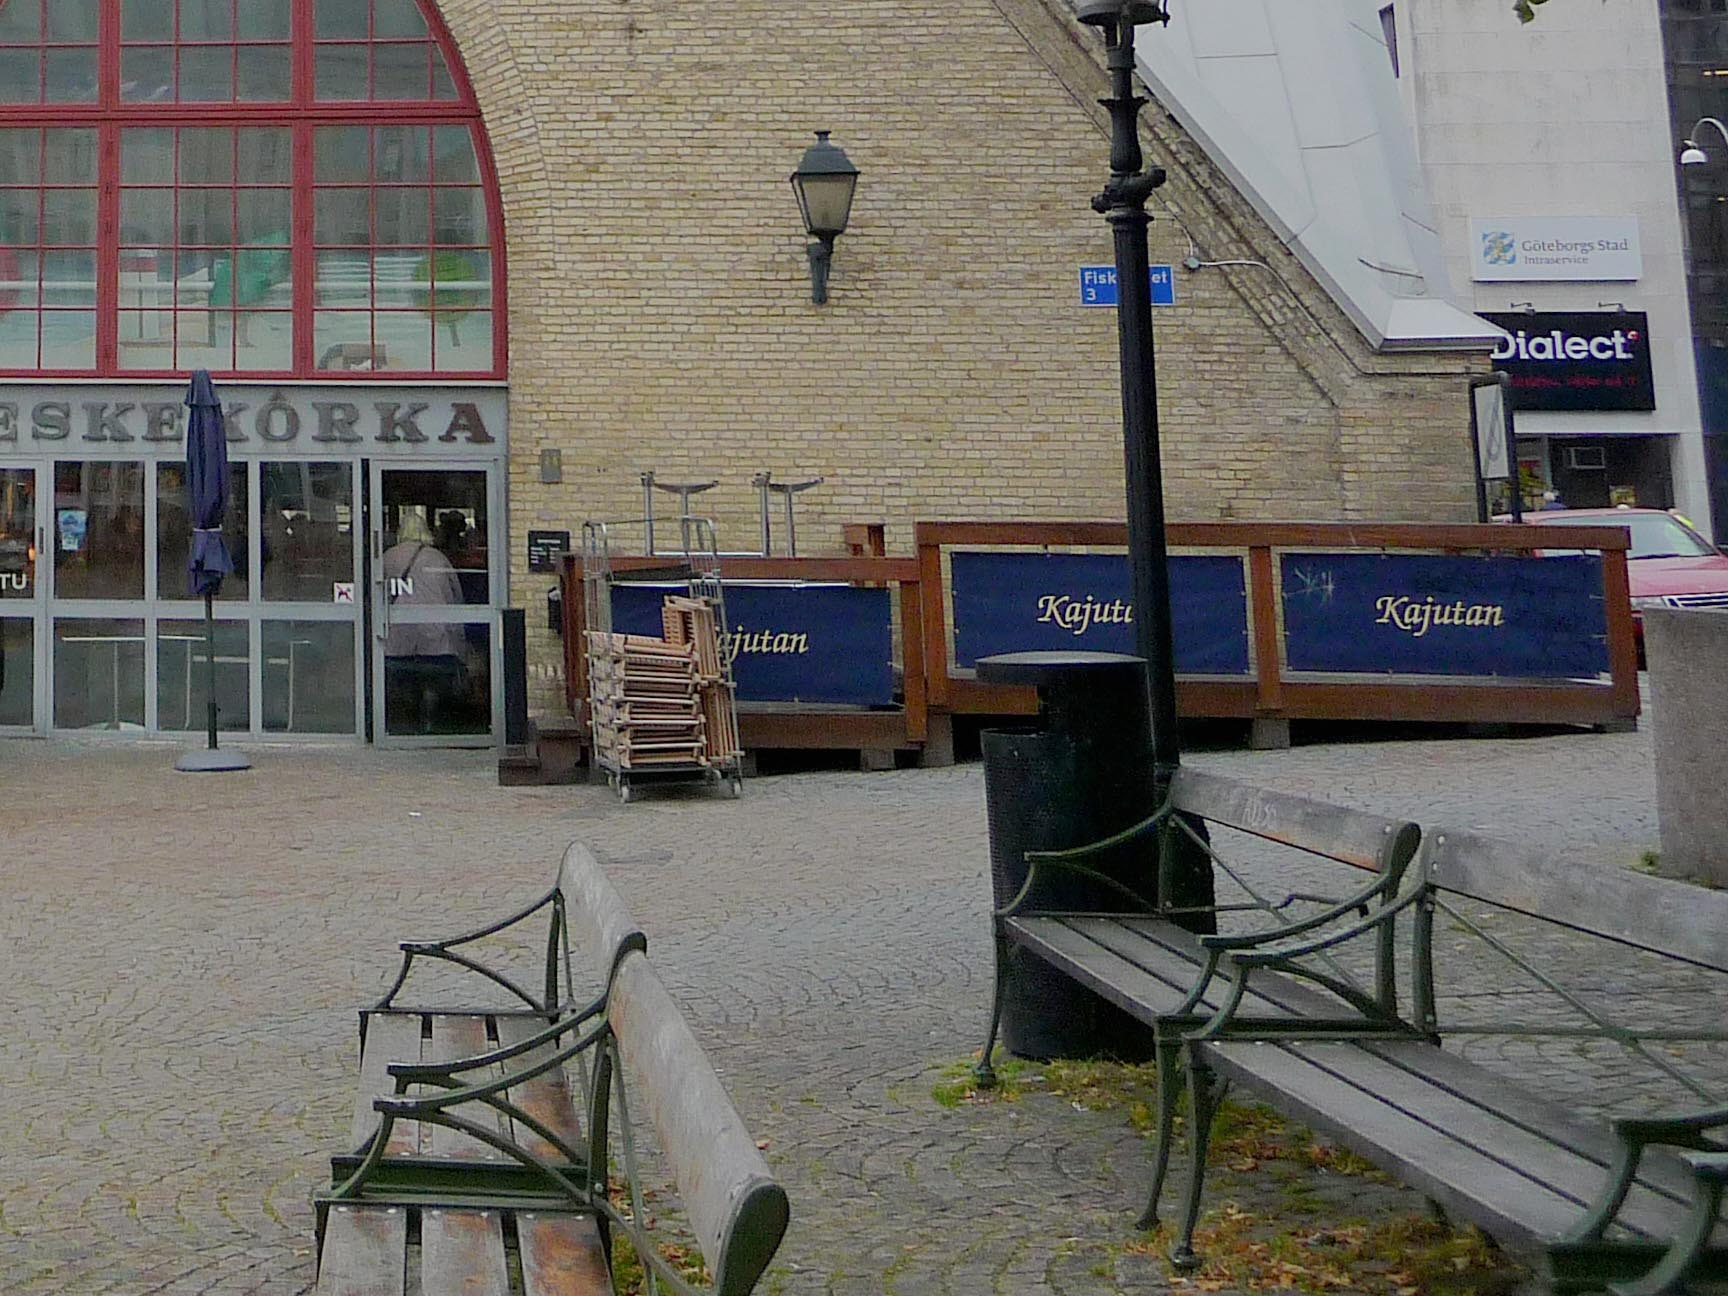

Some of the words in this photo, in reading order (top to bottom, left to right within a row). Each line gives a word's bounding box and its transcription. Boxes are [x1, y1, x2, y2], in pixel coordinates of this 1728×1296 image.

[1521, 239, 1594, 254] Göteborgs
[1598, 238, 1629, 251] Stad
[1524, 255, 1589, 265] Intraservice
[1086, 288, 1096, 301] 3
[1490, 330, 1634, 360] Dialect
[390, 578, 414, 596] IN
[1375, 596, 1504, 636] Kajutan
